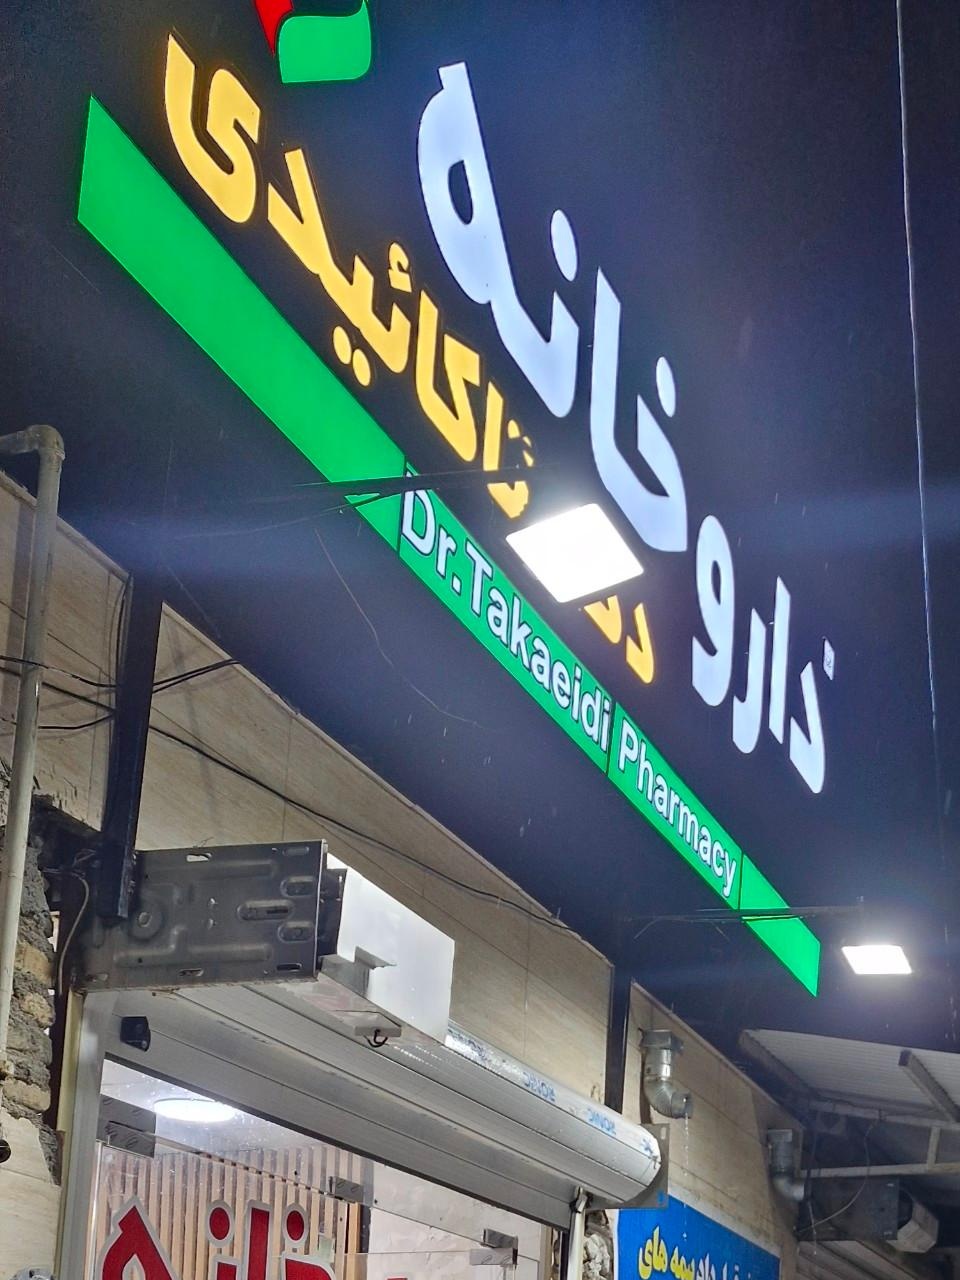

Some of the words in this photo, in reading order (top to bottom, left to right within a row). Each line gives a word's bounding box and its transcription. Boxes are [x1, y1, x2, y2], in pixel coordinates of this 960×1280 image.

[417, 62, 830, 794] داروخانه
[618, 719, 738, 898] Pharmacy
[638, 1225, 668, 1280] های
